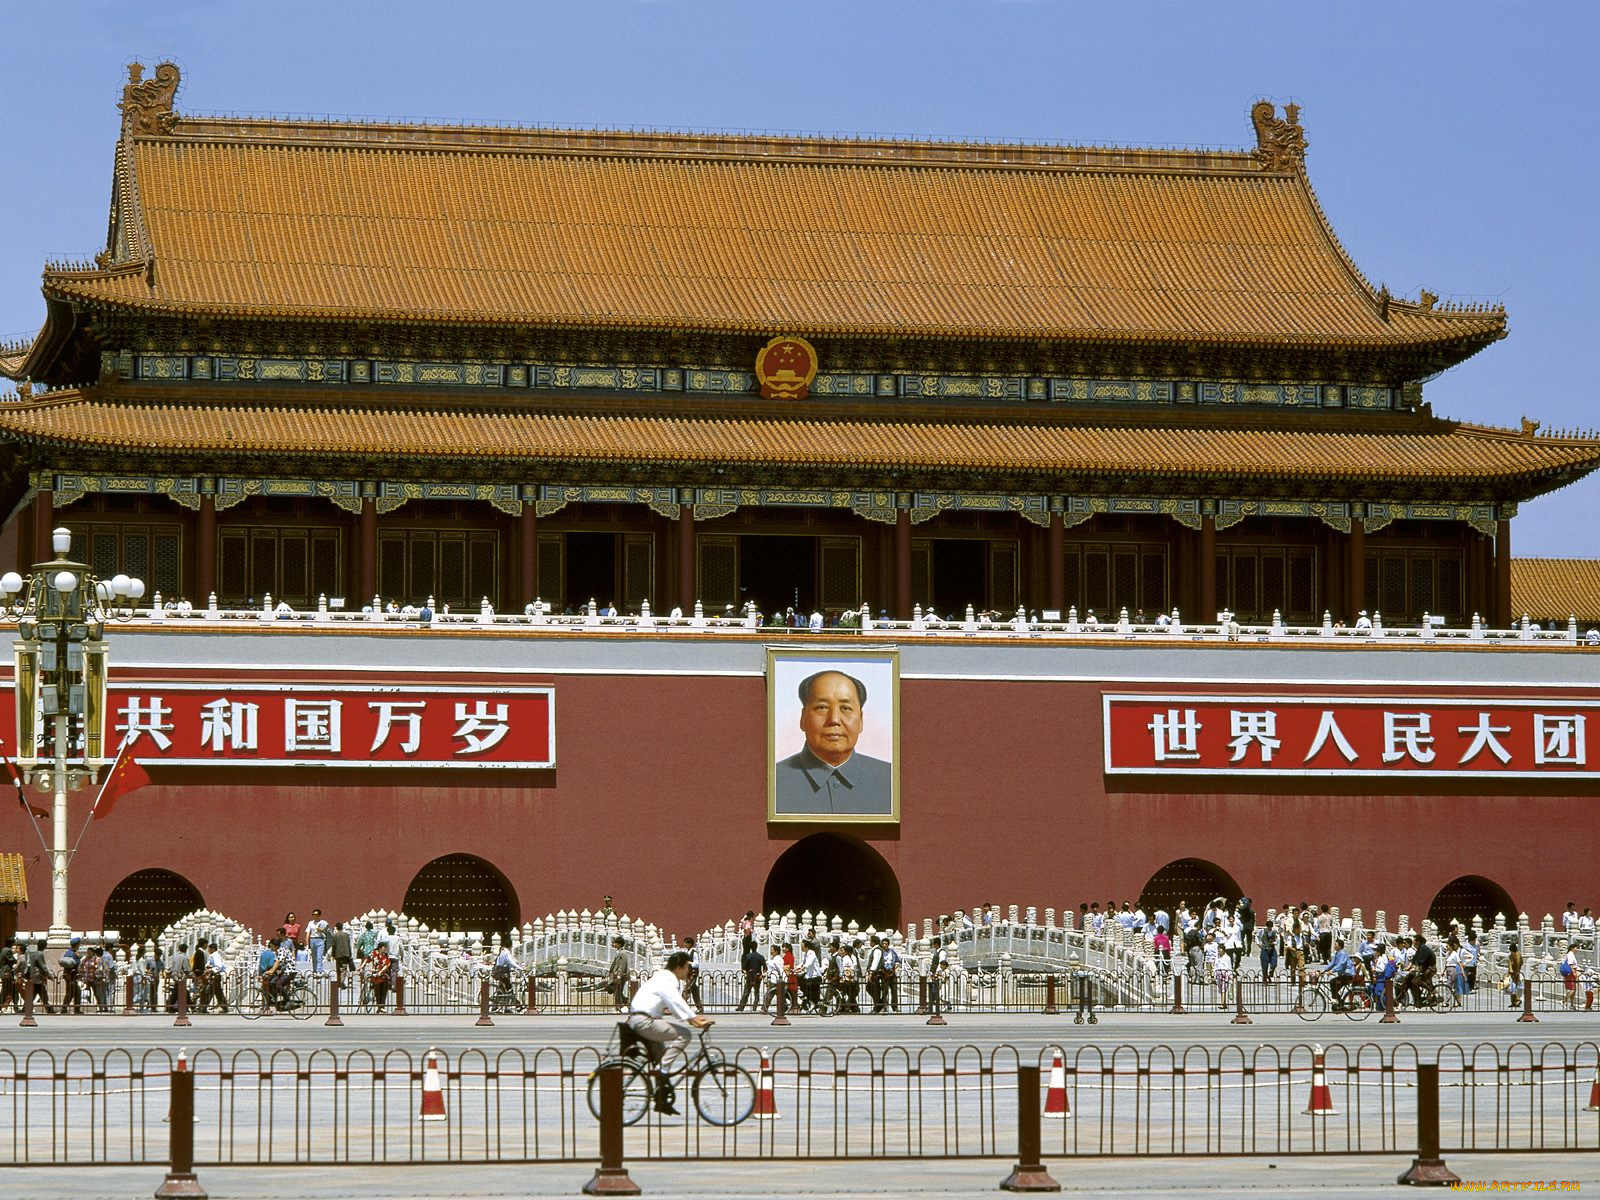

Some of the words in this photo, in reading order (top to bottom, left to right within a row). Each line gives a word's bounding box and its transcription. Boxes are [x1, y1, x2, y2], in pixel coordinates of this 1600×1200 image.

[1147, 708, 1587, 766] 世界人民大团
